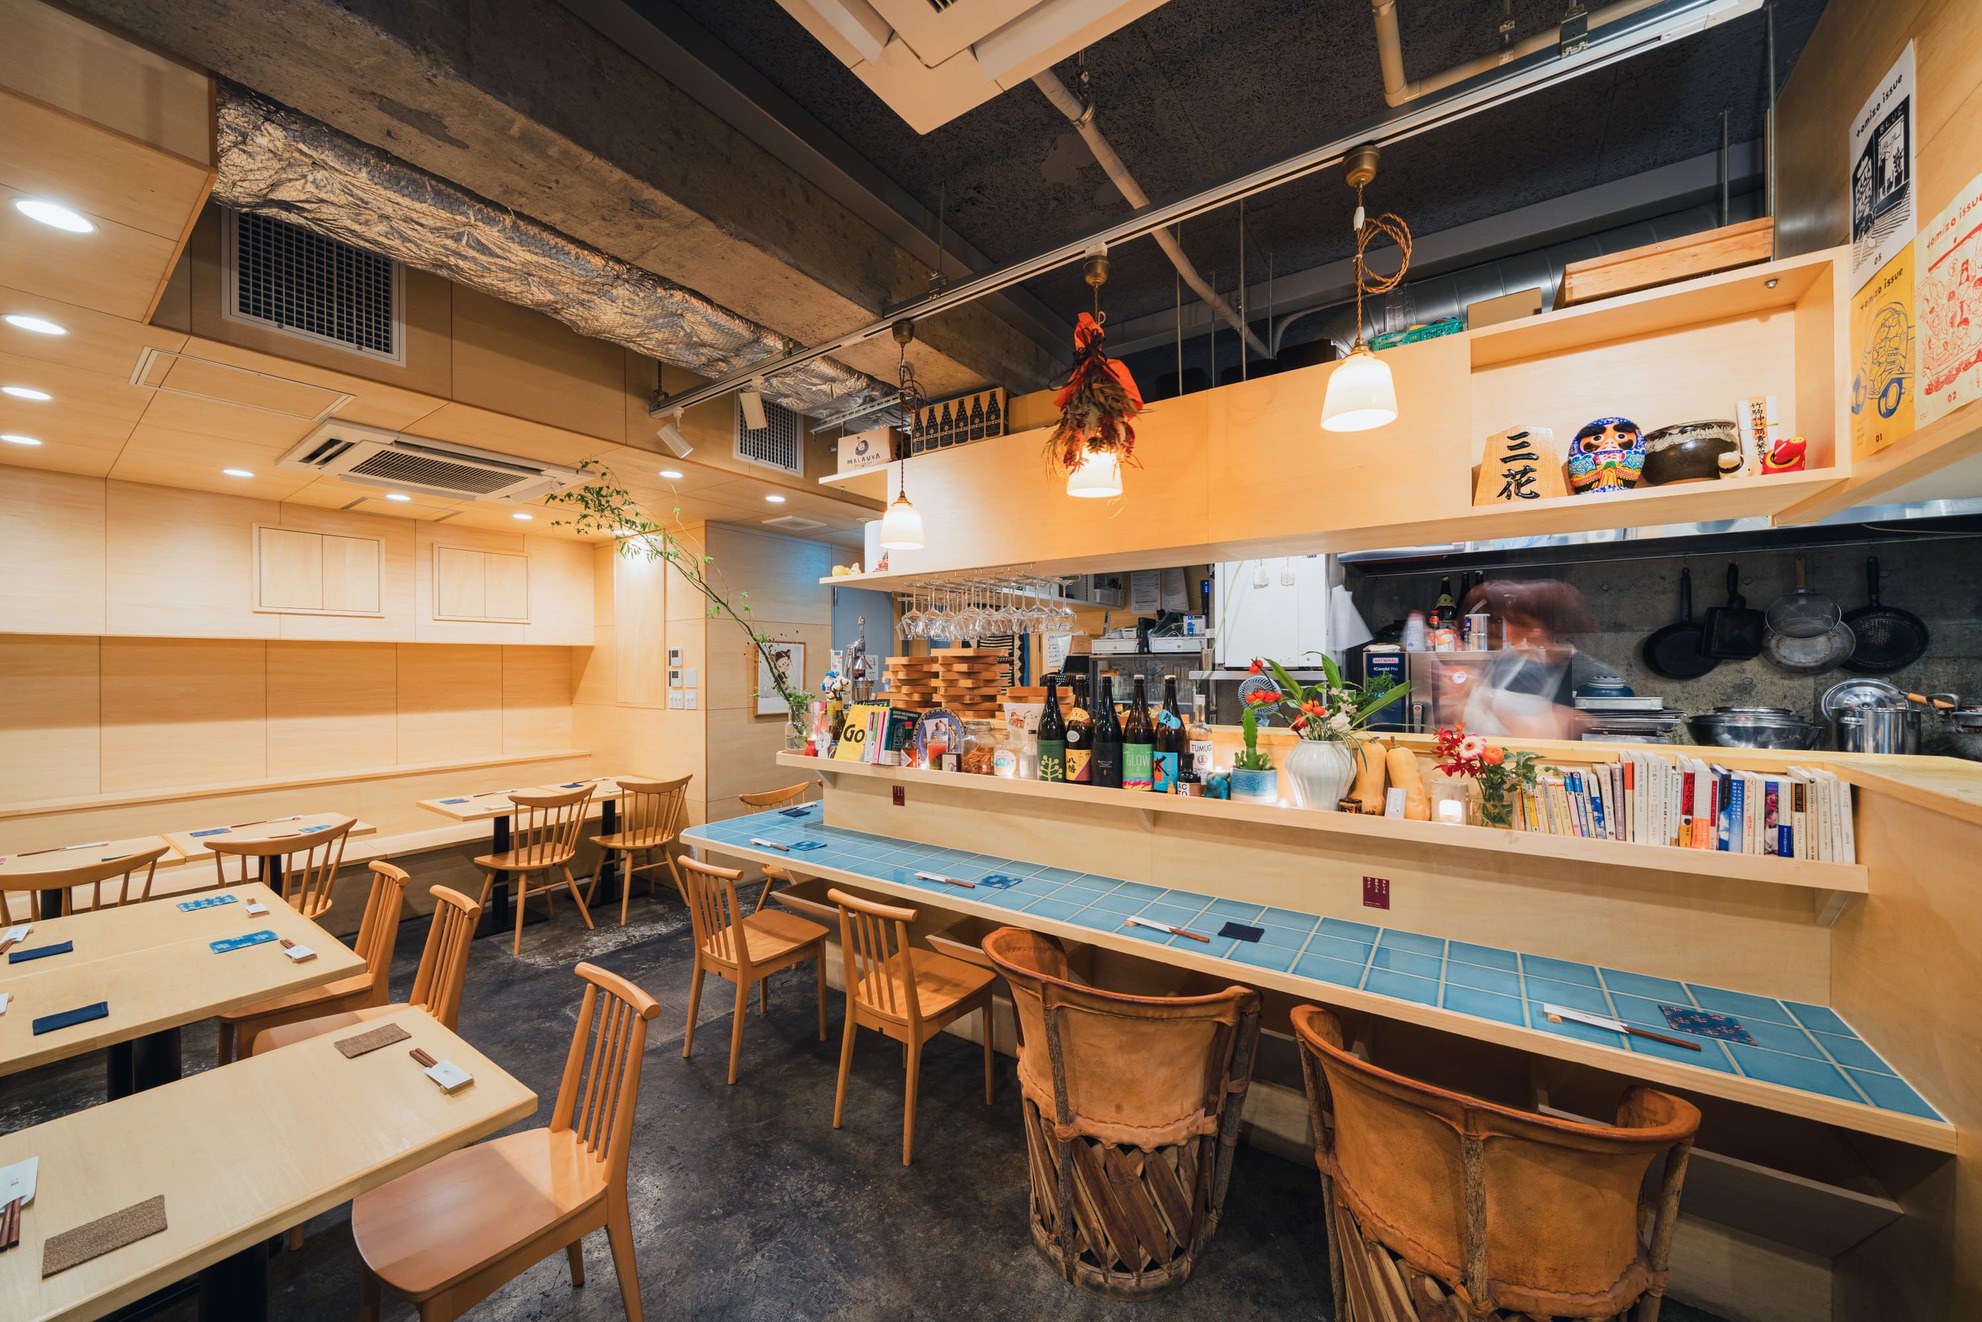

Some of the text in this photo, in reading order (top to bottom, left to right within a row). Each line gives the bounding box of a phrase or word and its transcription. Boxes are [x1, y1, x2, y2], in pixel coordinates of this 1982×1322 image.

[1856, 74, 1902, 138] tomizo issue
[1880, 104, 1904, 134] BLUE
[1926, 217, 1956, 249] tomizo
[1860, 267, 1903, 311] tomizo issue
[1947, 391, 1957, 403] 02
[1875, 433, 1882, 443] 01
[1497, 431, 1540, 500] 三花
[843, 724, 866, 744] Go
[1126, 754, 1150, 766] GLOW
